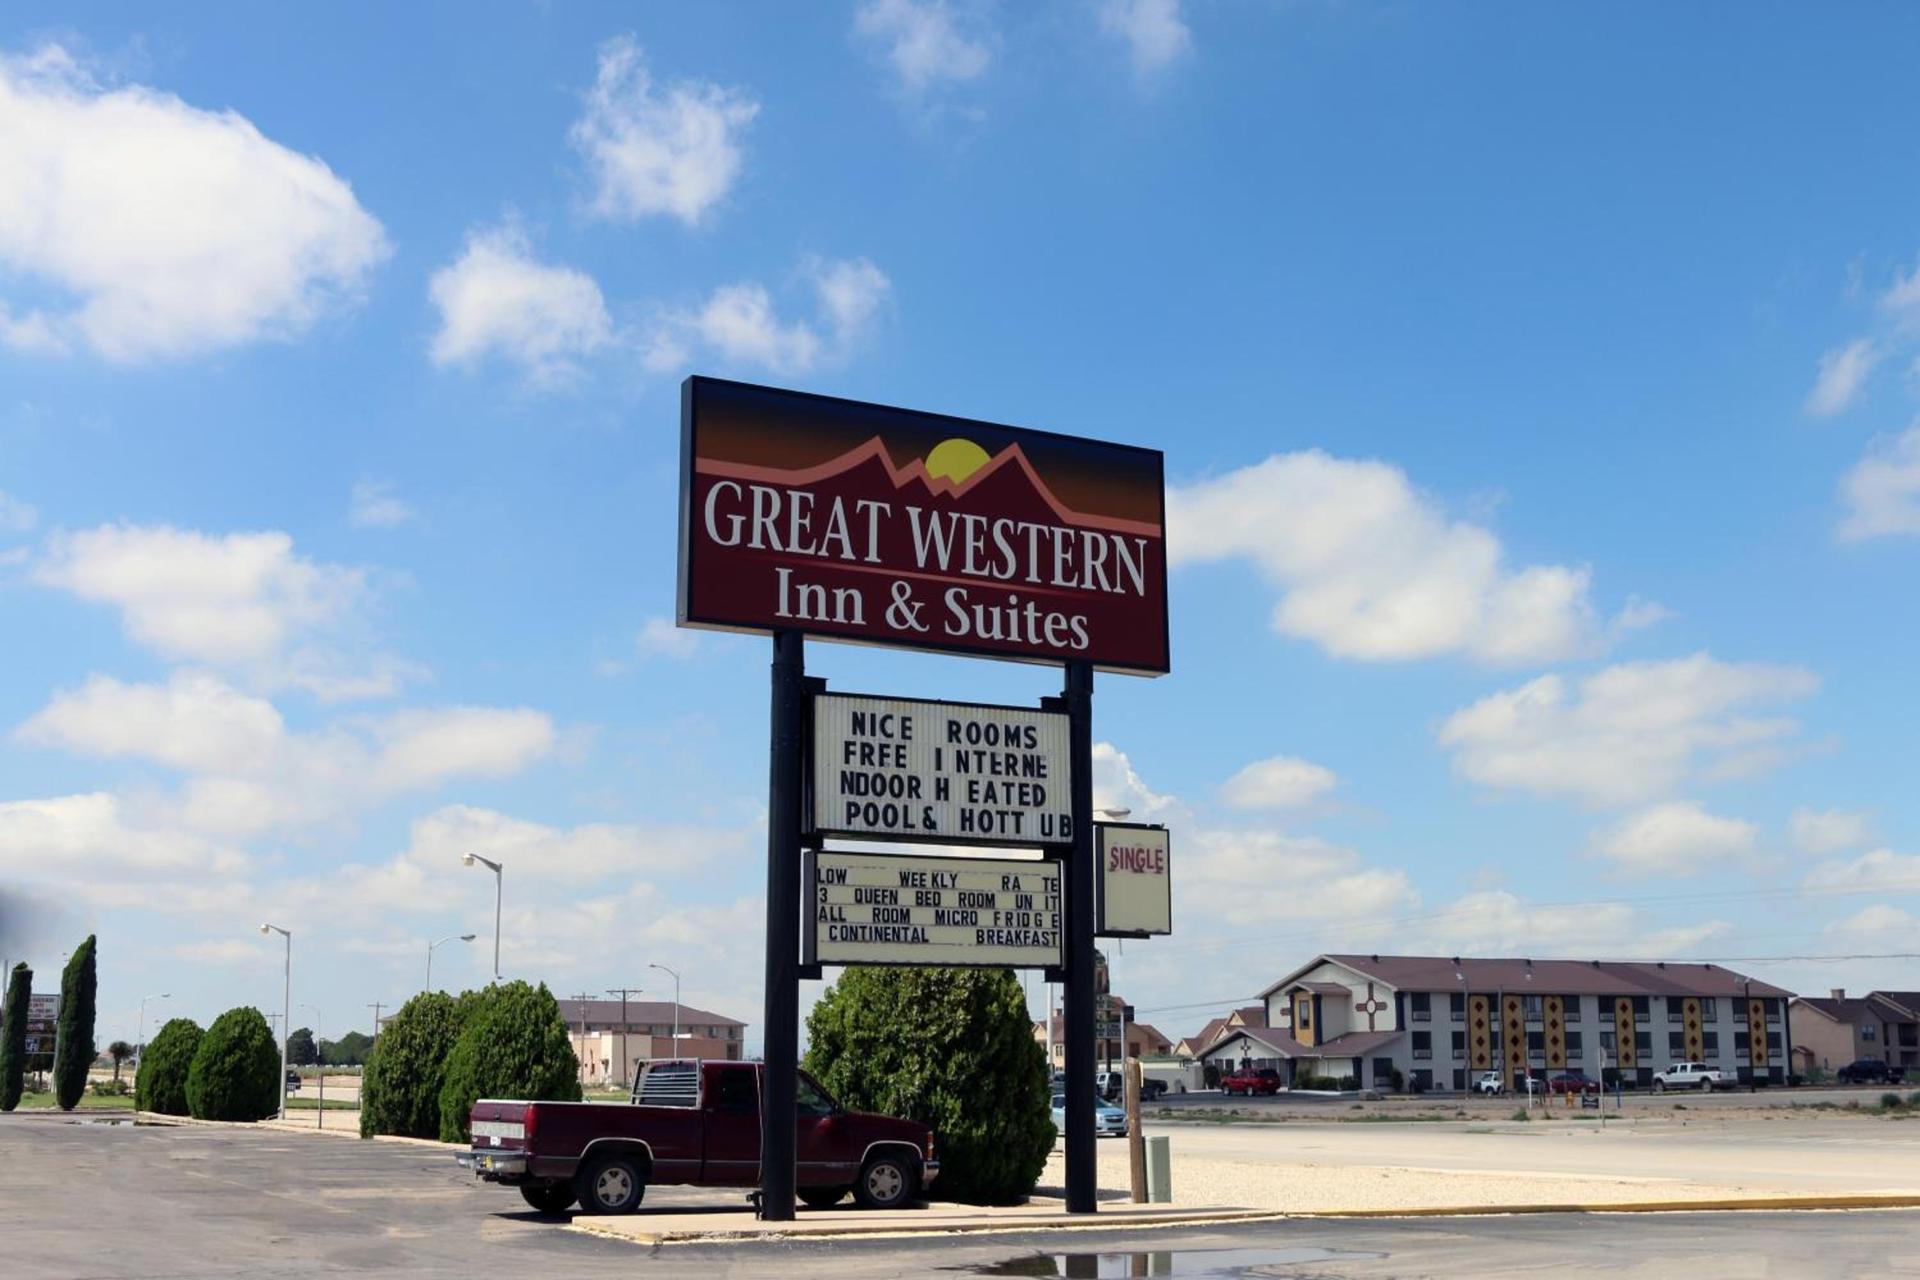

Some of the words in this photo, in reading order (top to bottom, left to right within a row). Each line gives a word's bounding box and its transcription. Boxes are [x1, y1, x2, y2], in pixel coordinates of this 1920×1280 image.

[704, 481, 890, 564] GREAT
[906, 505, 1148, 598] WESTERN
[775, 568, 867, 626] Inn
[885, 580, 930, 633] &
[944, 587, 1090, 650] Suites
[852, 711, 912, 740] NICE
[947, 720, 1037, 749] ROOMS
[840, 770, 921, 799] NDOOR
[1110, 846, 1164, 874] SINGLE
[817, 868, 847, 884] LOW
[819, 888, 828, 902] 3
[915, 891, 942, 907] BED
[958, 892, 996, 909] ROOM
[818, 906, 847, 922] ALL
[872, 908, 911, 924] ROOM
[934, 910, 978, 926] MICRO
[829, 925, 929, 943] CONTINENTAL
[976, 929, 1058, 947] BREAKFAST
